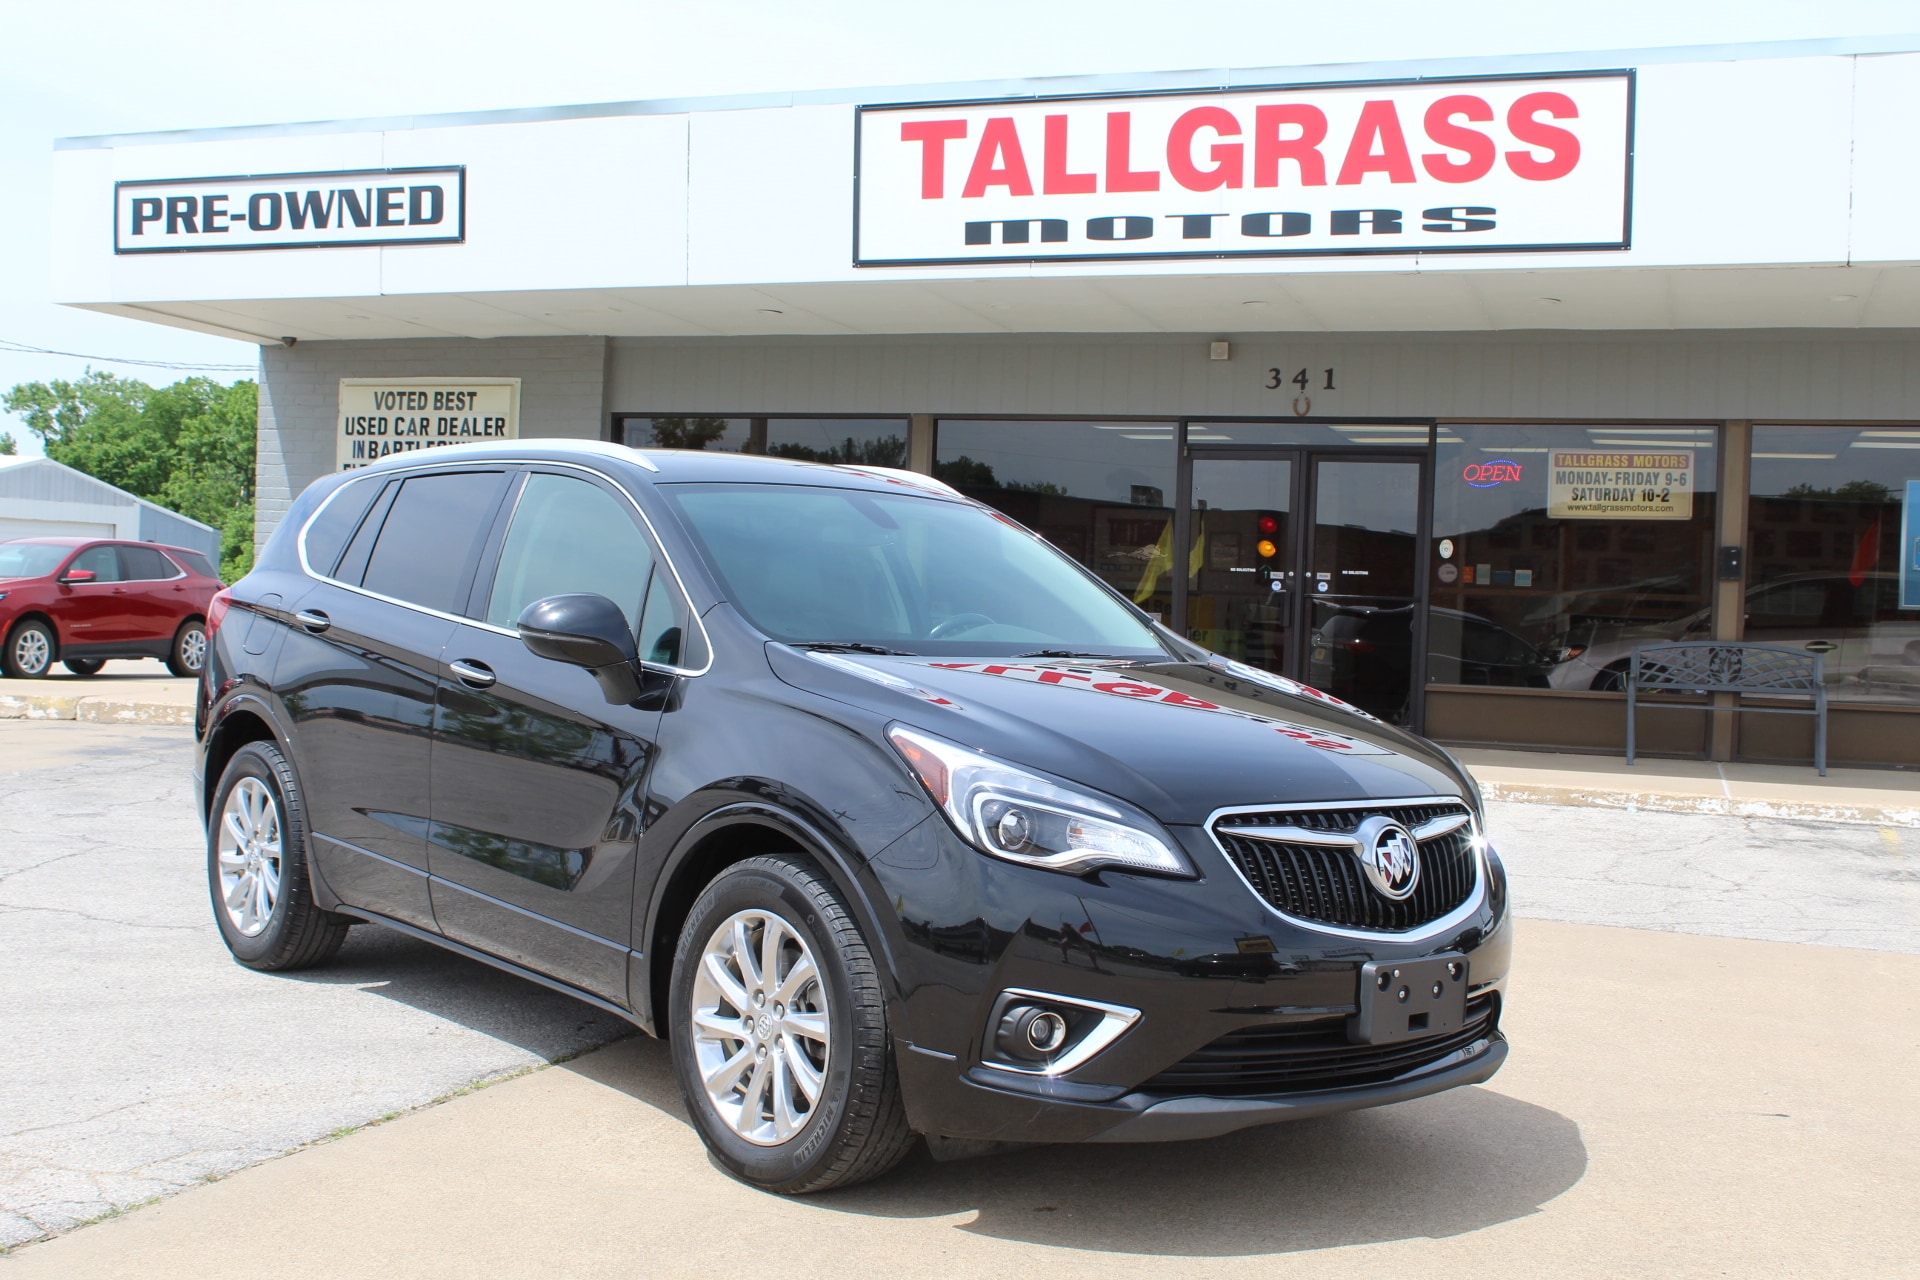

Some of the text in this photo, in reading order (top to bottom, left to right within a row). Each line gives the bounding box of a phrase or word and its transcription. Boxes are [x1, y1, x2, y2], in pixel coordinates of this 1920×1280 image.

[902, 91, 1581, 199] TALLGRASS
[131, 184, 444, 236] PRE-OWNED
[964, 206, 1497, 246] MOTORS
[1265, 367, 1336, 390] 341
[374, 391, 477, 411] VOTED BEST
[345, 416, 506, 436] USED CAR DEALER
[352, 440, 365, 458] IN
[1558, 454, 1687, 468] TALLGRASS MOTORS
[1463, 464, 1523, 481] OPEN
[1555, 470, 1687, 486] MONDAY-FRIDAY 9-6
[1571, 487, 1670, 503] SATURDAY 10-2
[1567, 503, 1674, 513] www.tallgrassmotors.com
[794, 1105, 836, 1168] MICHELIN
